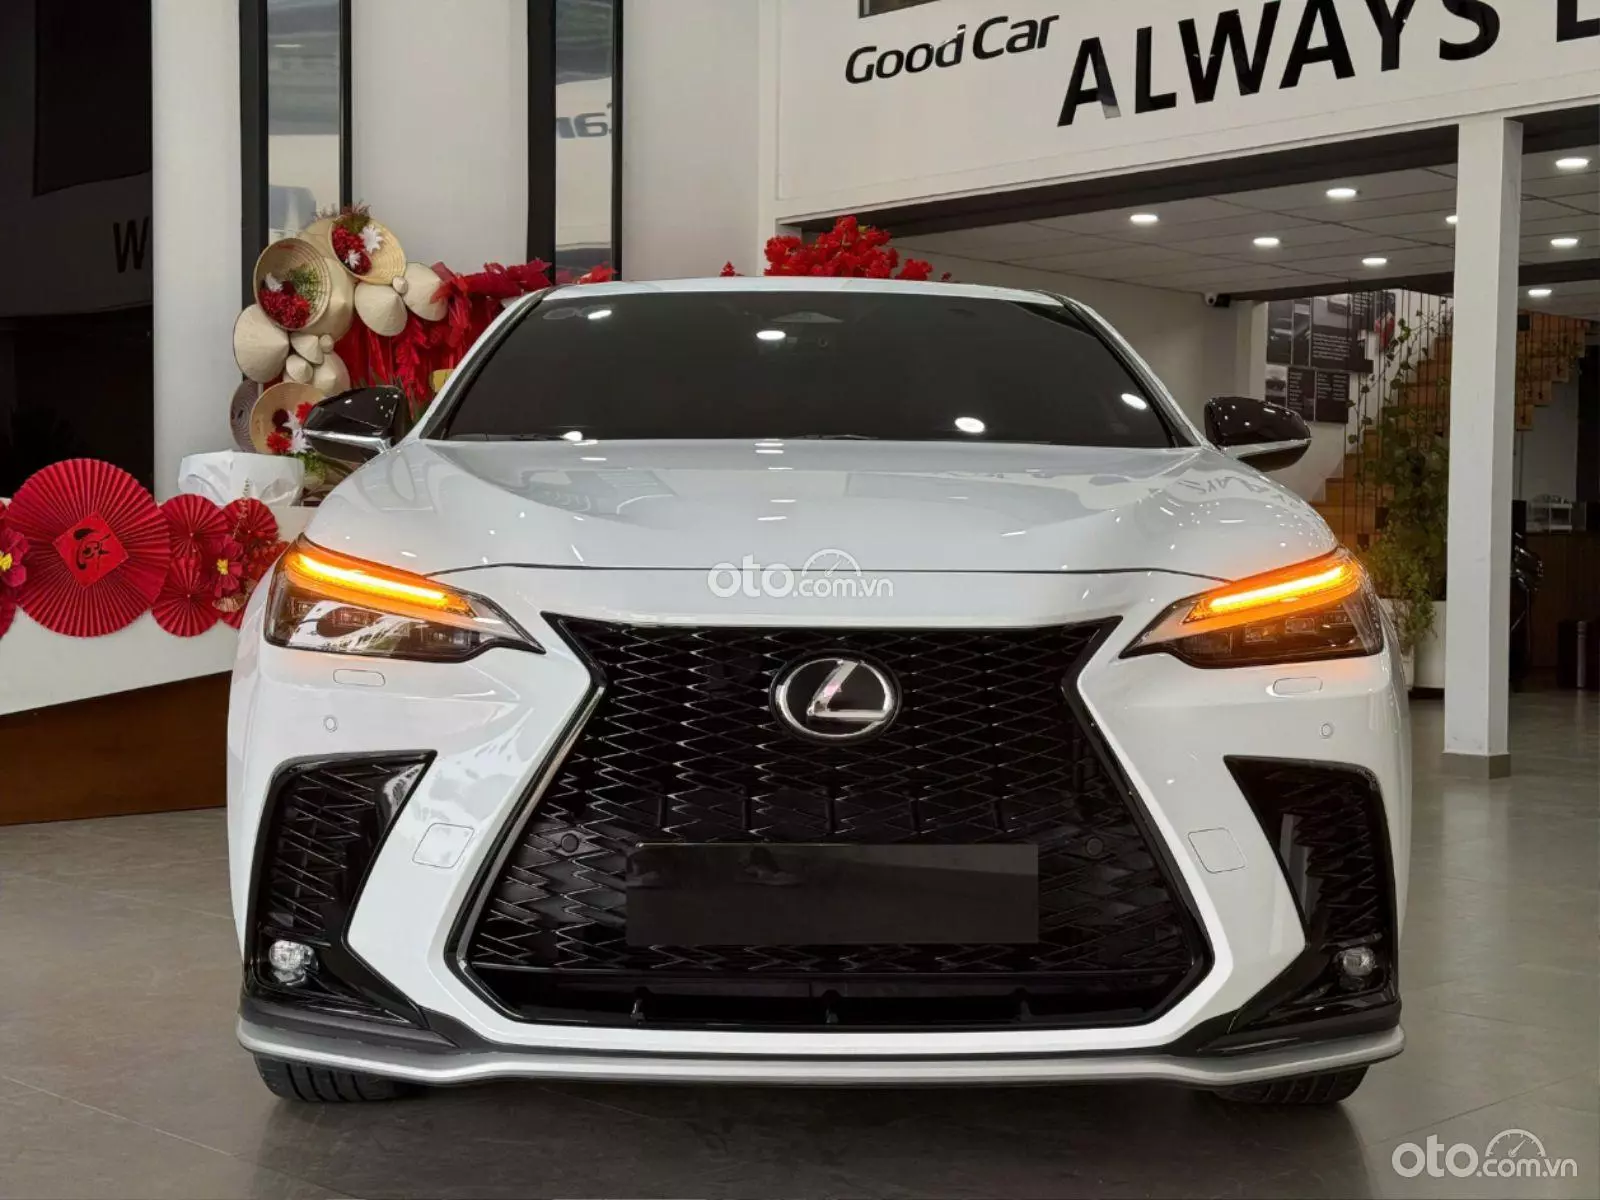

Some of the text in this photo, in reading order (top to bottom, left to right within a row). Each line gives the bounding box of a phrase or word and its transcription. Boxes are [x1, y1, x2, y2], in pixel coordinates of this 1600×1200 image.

[845, 15, 1060, 84] Good Car
[1057, 0, 1501, 128] ALWAYS
